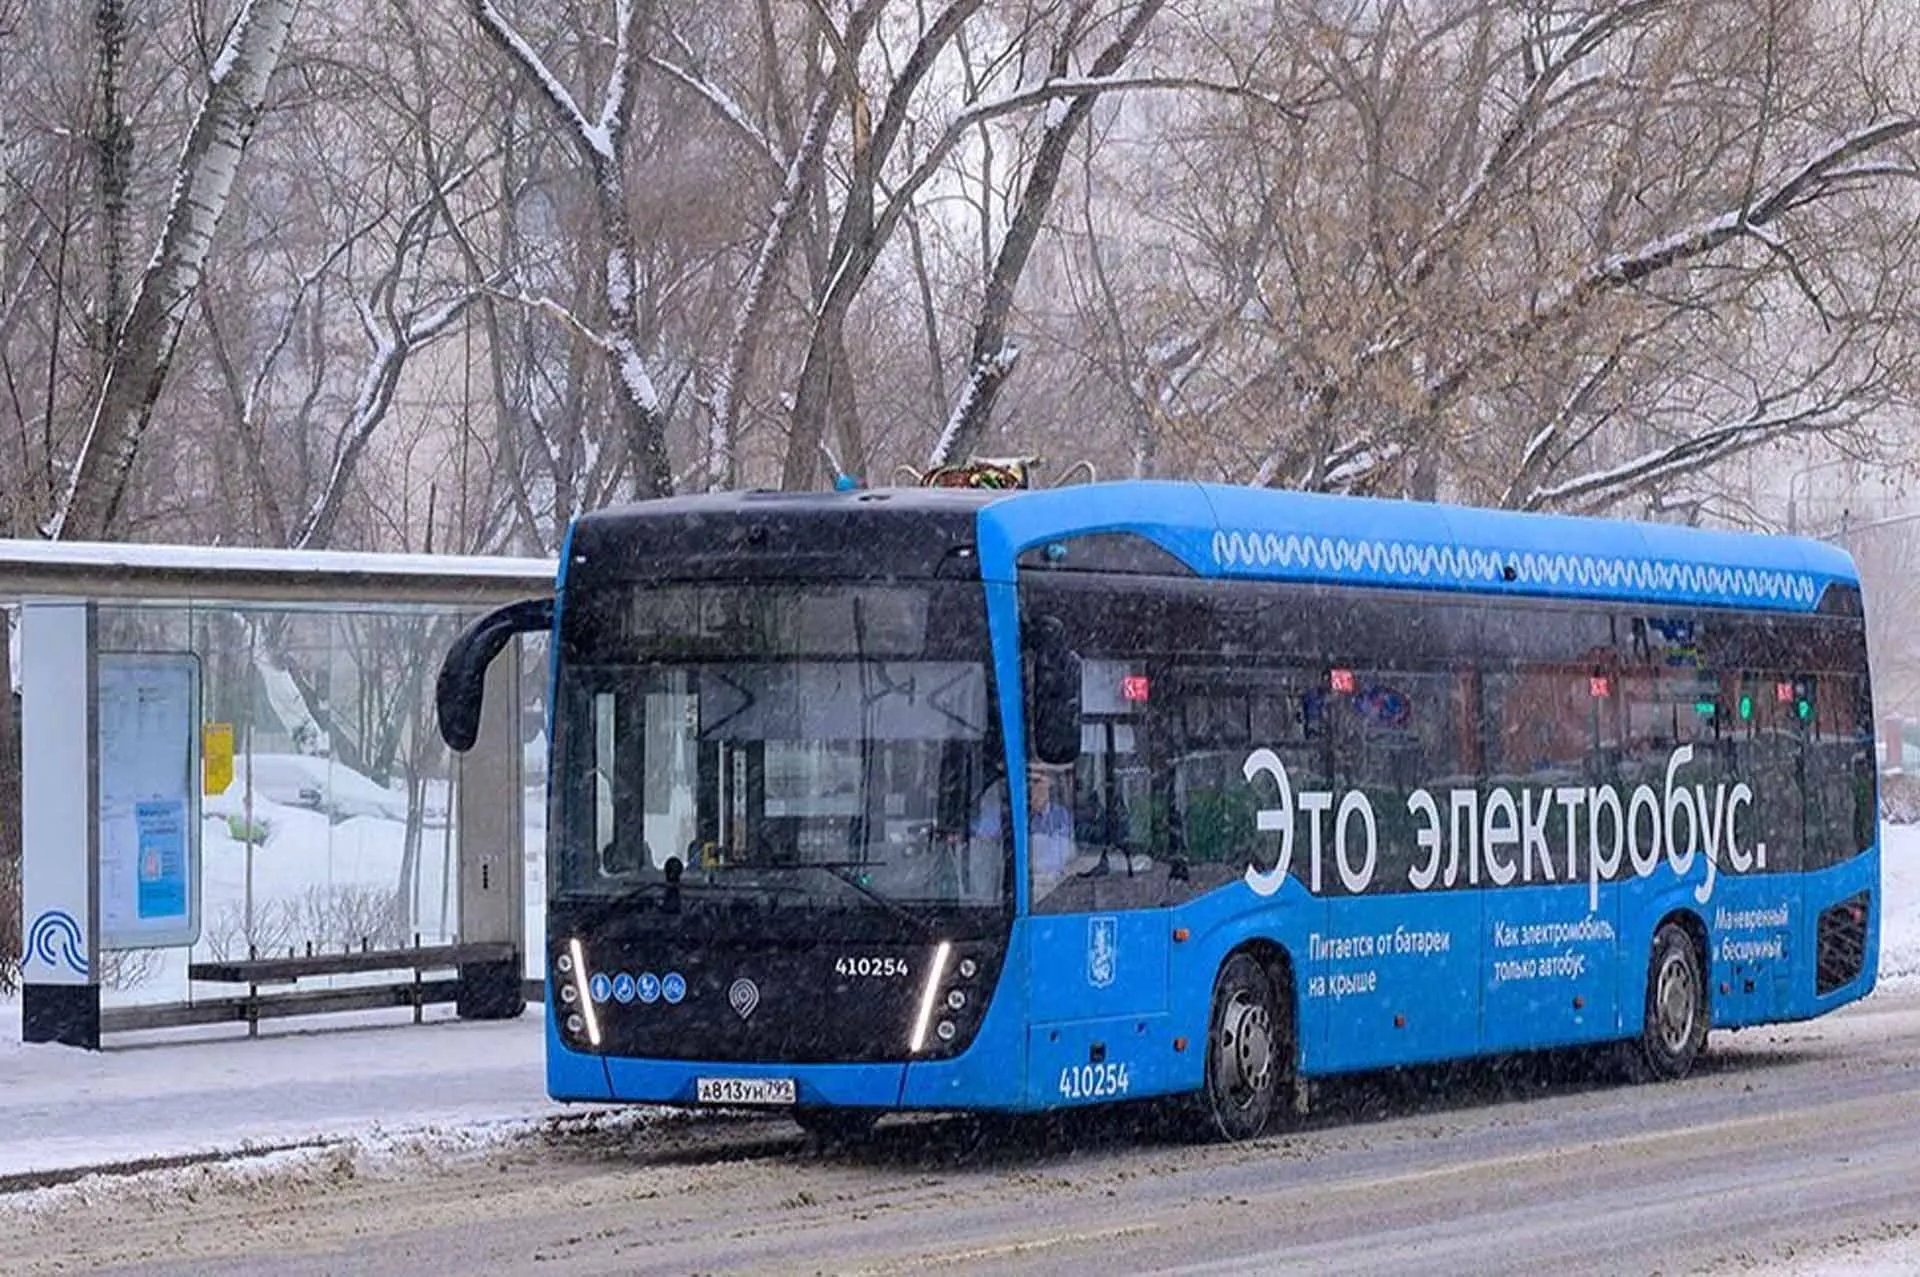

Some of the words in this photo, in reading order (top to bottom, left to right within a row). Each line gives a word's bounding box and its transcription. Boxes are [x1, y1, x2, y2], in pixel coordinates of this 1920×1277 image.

[1243, 748, 1377, 896] Это
[1407, 744, 1766, 911] электробус.
[1309, 932, 1374, 961] Питается
[1376, 934, 1393, 955] от
[1395, 925, 1450, 957] батареи
[1494, 920, 1519, 948] Как
[835, 957, 908, 977] 410254
[1494, 959, 1536, 980] только
[1538, 947, 1585, 980] автобус
[1308, 975, 1325, 997] на
[1328, 970, 1376, 1000] крыше
[1059, 1063, 1129, 1098] 410254
